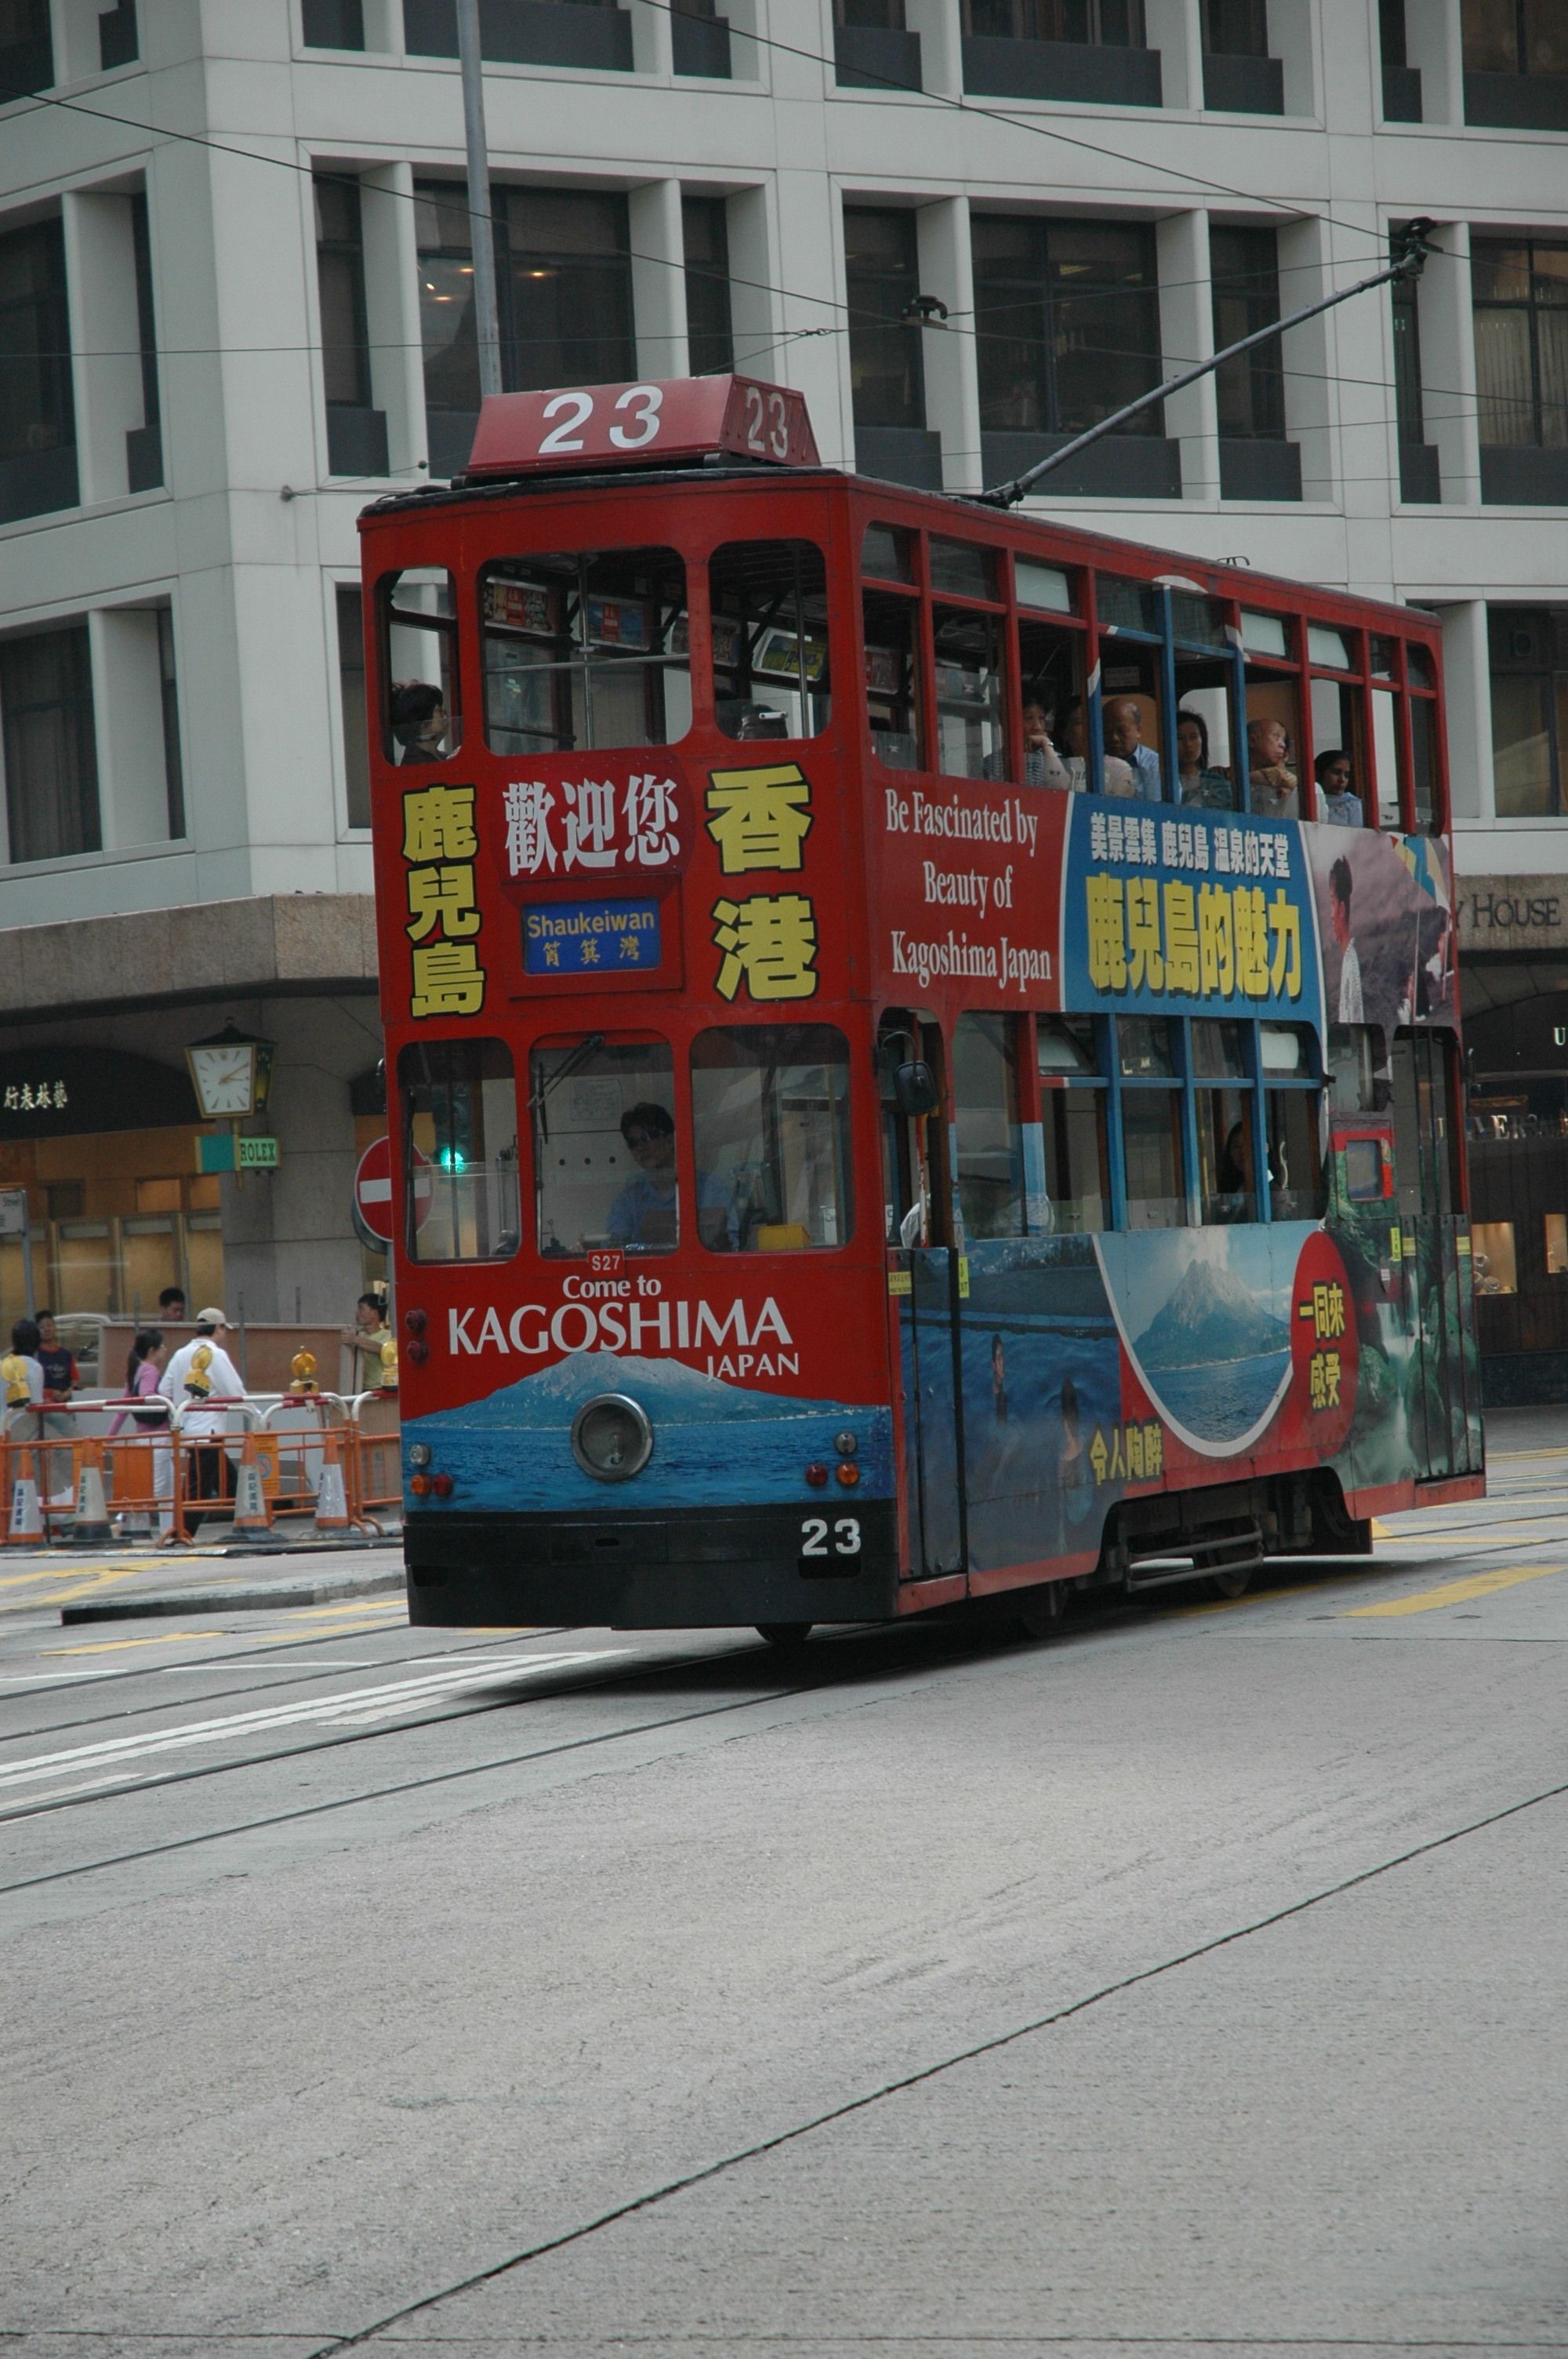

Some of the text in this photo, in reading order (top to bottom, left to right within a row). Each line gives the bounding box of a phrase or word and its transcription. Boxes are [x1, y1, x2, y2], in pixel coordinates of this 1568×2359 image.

[538, 385, 663, 453] 23
[746, 387, 789, 459] 23
[502, 773, 681, 876] 歡迎您
[886, 788, 1038, 856] Be Fascinated by
[1091, 812, 1157, 866] 美景雲集
[1162, 820, 1209, 870] 鹿兒島
[402, 785, 485, 1017] 鹿兒島
[705, 763, 818, 1001] 香港
[923, 860, 1014, 918] Beauty of
[527, 910, 655, 938] Shaukeiwan
[543, 935, 641, 967] 筲箕灣
[1085, 872, 1301, 998] 鹿兒島的魅力
[891, 930, 1052, 992] Kagoshima Japan
[240, 1142, 276, 1161] ROLEX
[562, 1274, 662, 1299] Come to
[592, 1255, 621, 1271] S27
[448, 1296, 793, 1355] KAGOSHIMA
[706, 1352, 800, 1382] JAPAN
[1089, 1423, 1162, 1486] 令人陶醉
[800, 1518, 861, 1556] 23
